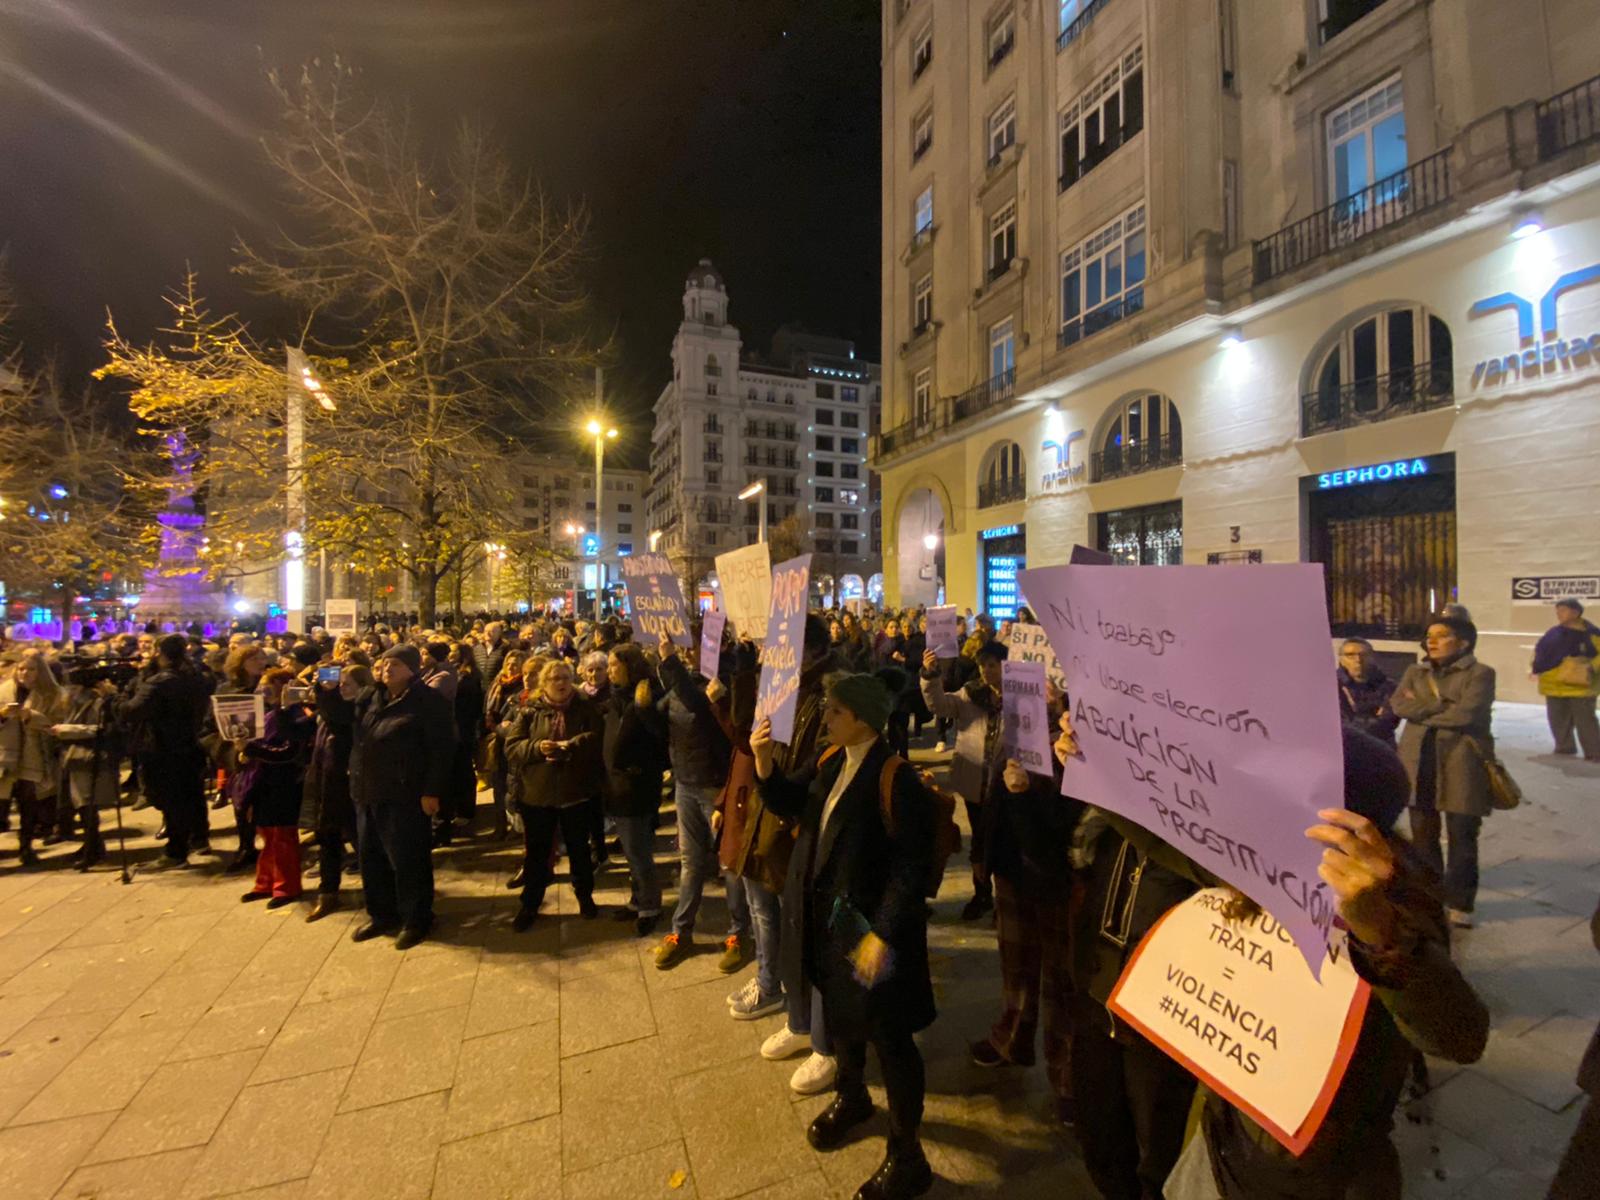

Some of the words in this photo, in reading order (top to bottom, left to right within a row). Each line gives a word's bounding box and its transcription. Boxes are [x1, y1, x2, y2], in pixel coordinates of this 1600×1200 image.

[1318, 459, 1427, 489] SEPHORA
[1230, 525, 1241, 543] 3
[1049, 598, 1088, 634] Ni
[1097, 610, 1175, 656] trabajo
[1152, 689, 1270, 739] elección
[1127, 758, 1165, 793] DE
[1174, 783, 1211, 817] LA
[1208, 923, 1274, 972] TRATA
[1166, 963, 1279, 1050] VIOLENCIA
[1158, 995, 1262, 1075] #HARTAS
